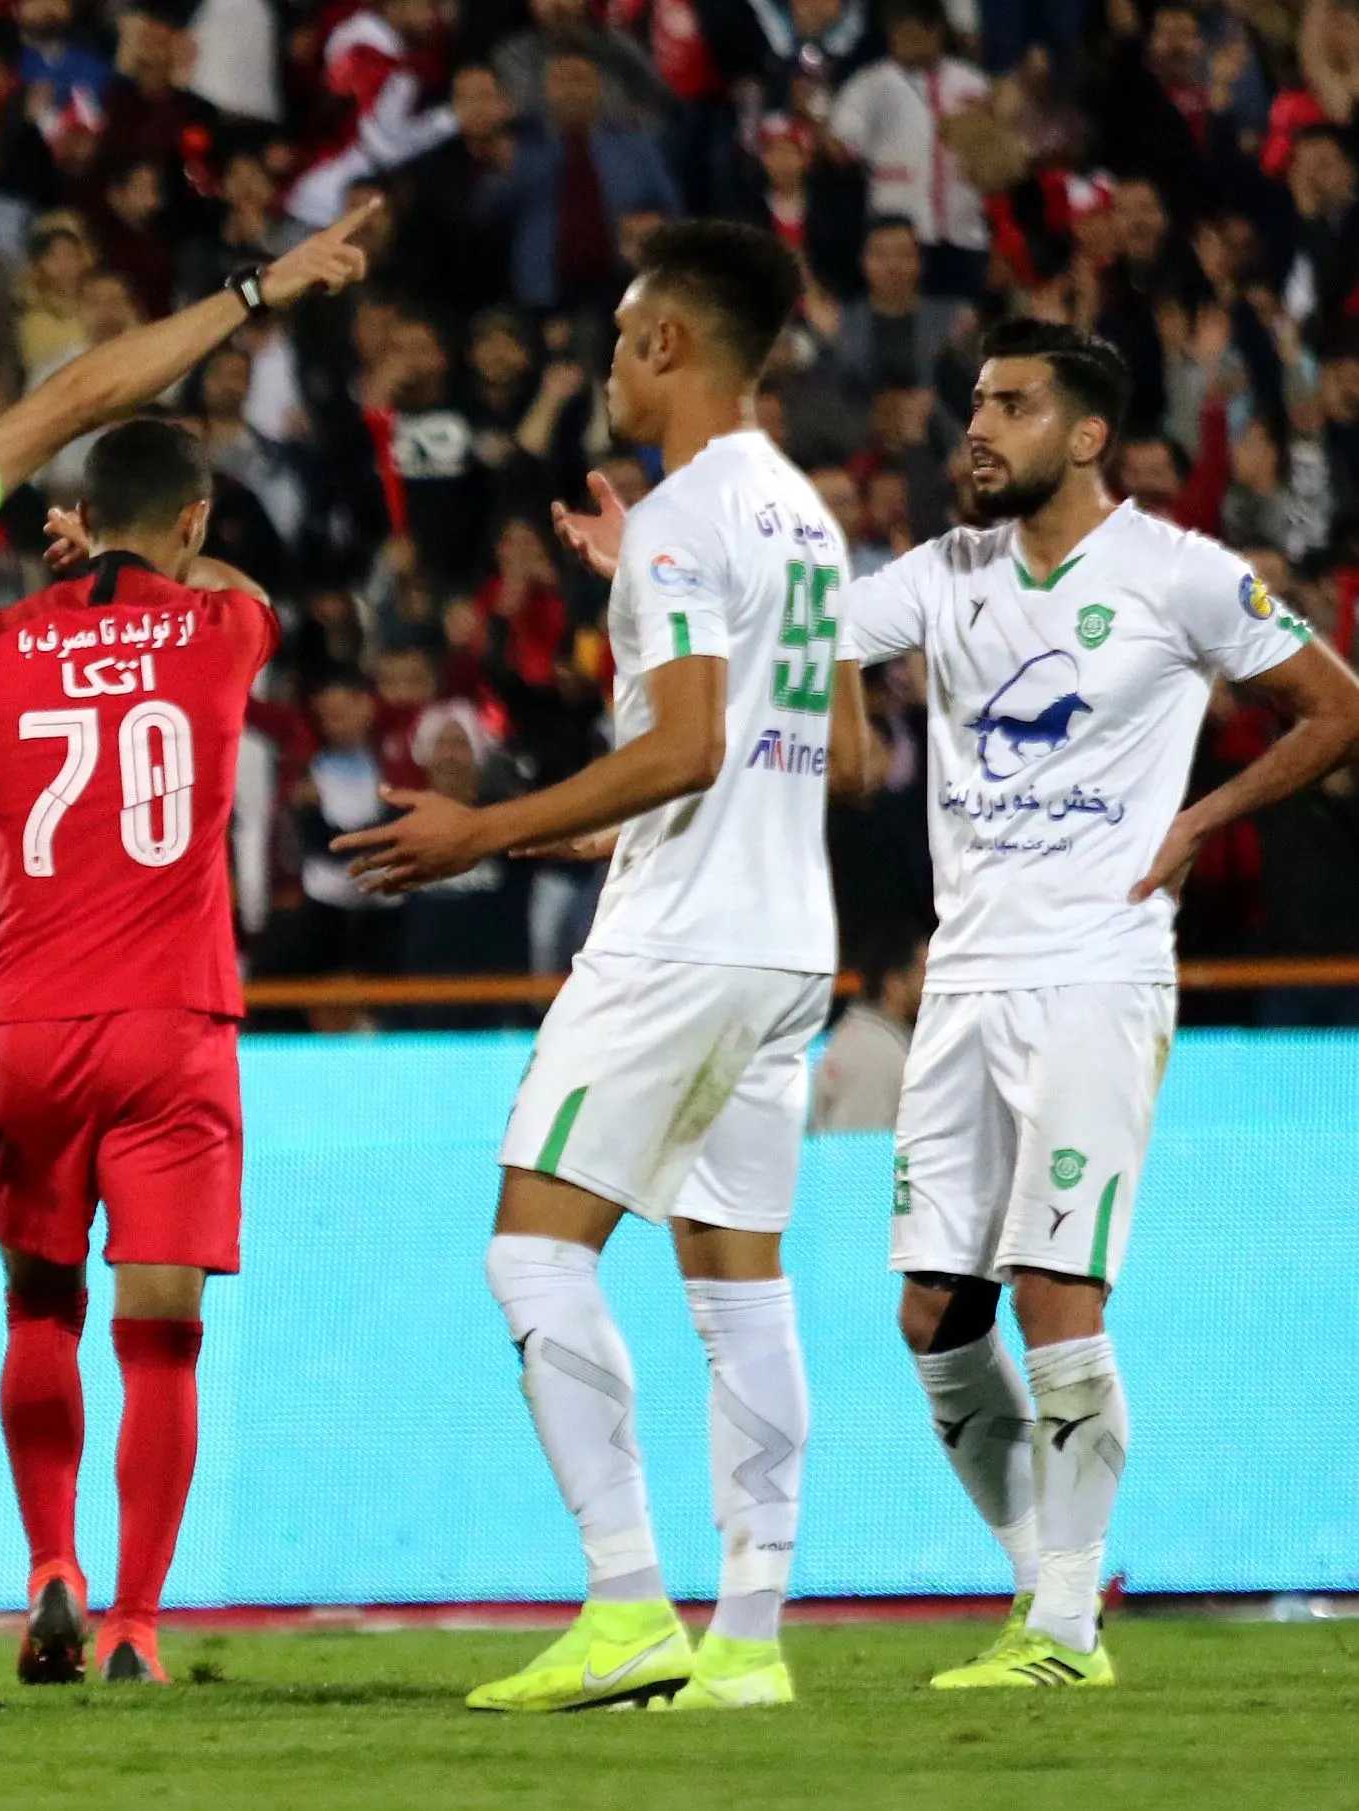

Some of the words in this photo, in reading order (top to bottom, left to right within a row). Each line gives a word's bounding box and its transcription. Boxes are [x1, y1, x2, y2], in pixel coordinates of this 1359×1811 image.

[17, 628, 34, 660] با
[35, 624, 97, 659] مصرف
[99, 617, 118, 646] تا
[119, 612, 171, 649] تولید
[175, 610, 194, 647] از
[61, 654, 157, 698] اتکا
[18, 700, 195, 877] 70
